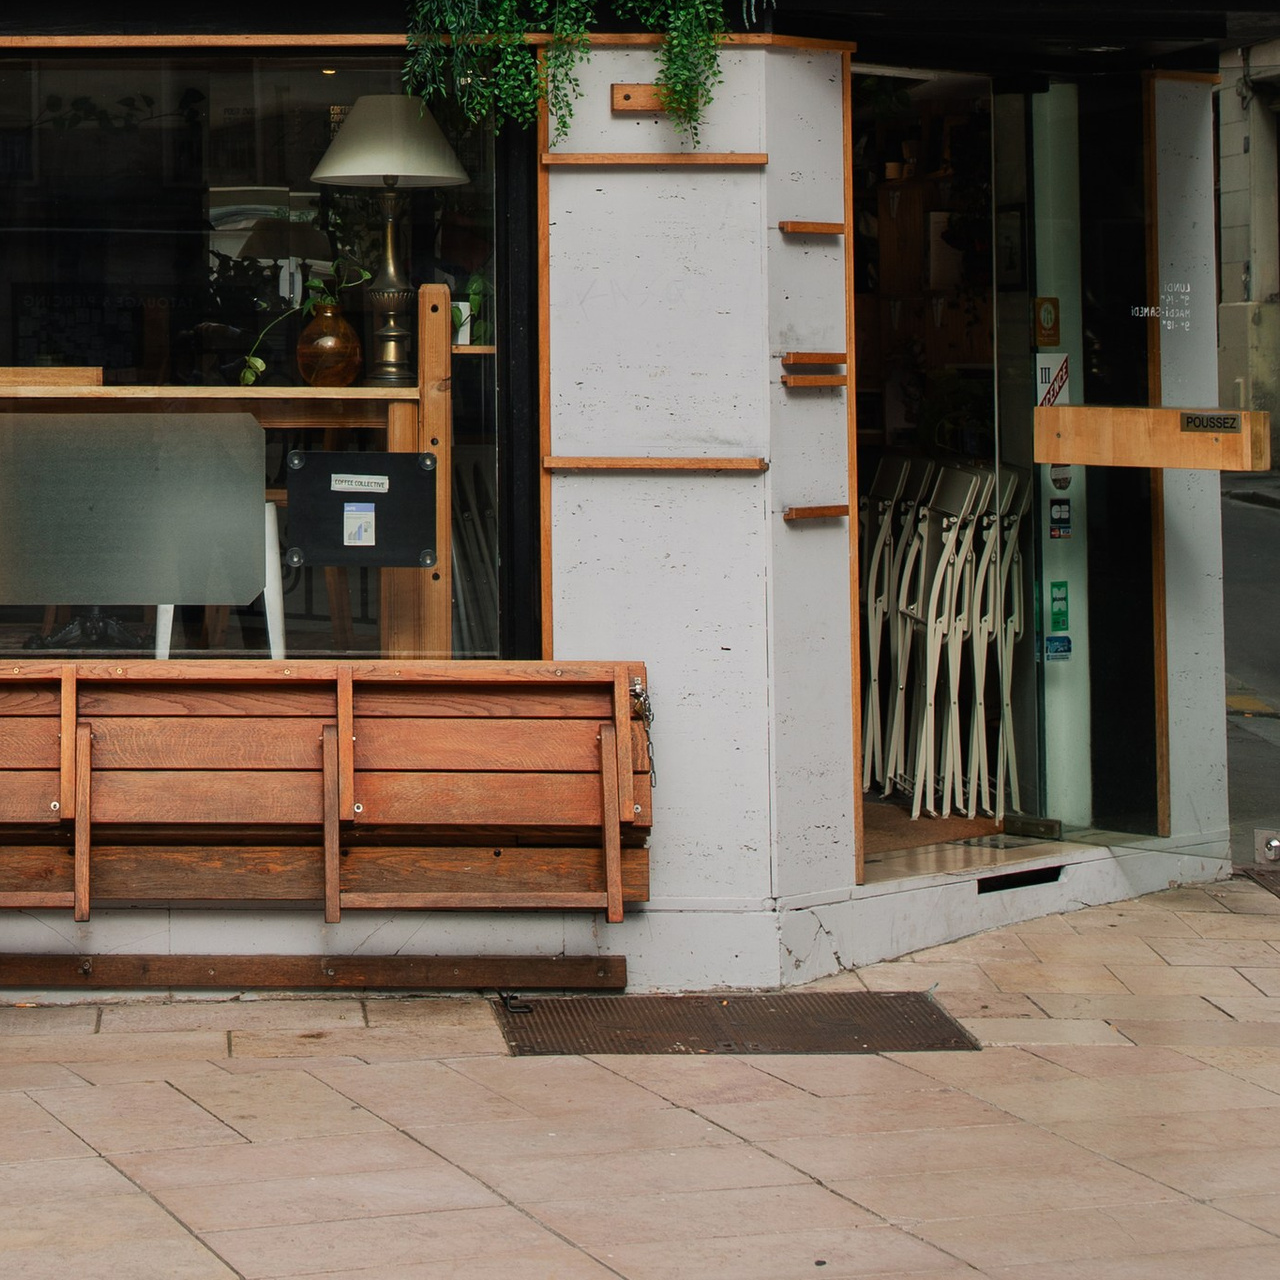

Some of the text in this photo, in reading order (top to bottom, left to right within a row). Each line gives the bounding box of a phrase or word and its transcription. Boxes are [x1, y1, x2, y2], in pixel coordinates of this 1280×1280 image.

[1186, 415, 1237, 429] POUSSEZ
[334, 479, 385, 489] COFFEE COLLECTIVE
